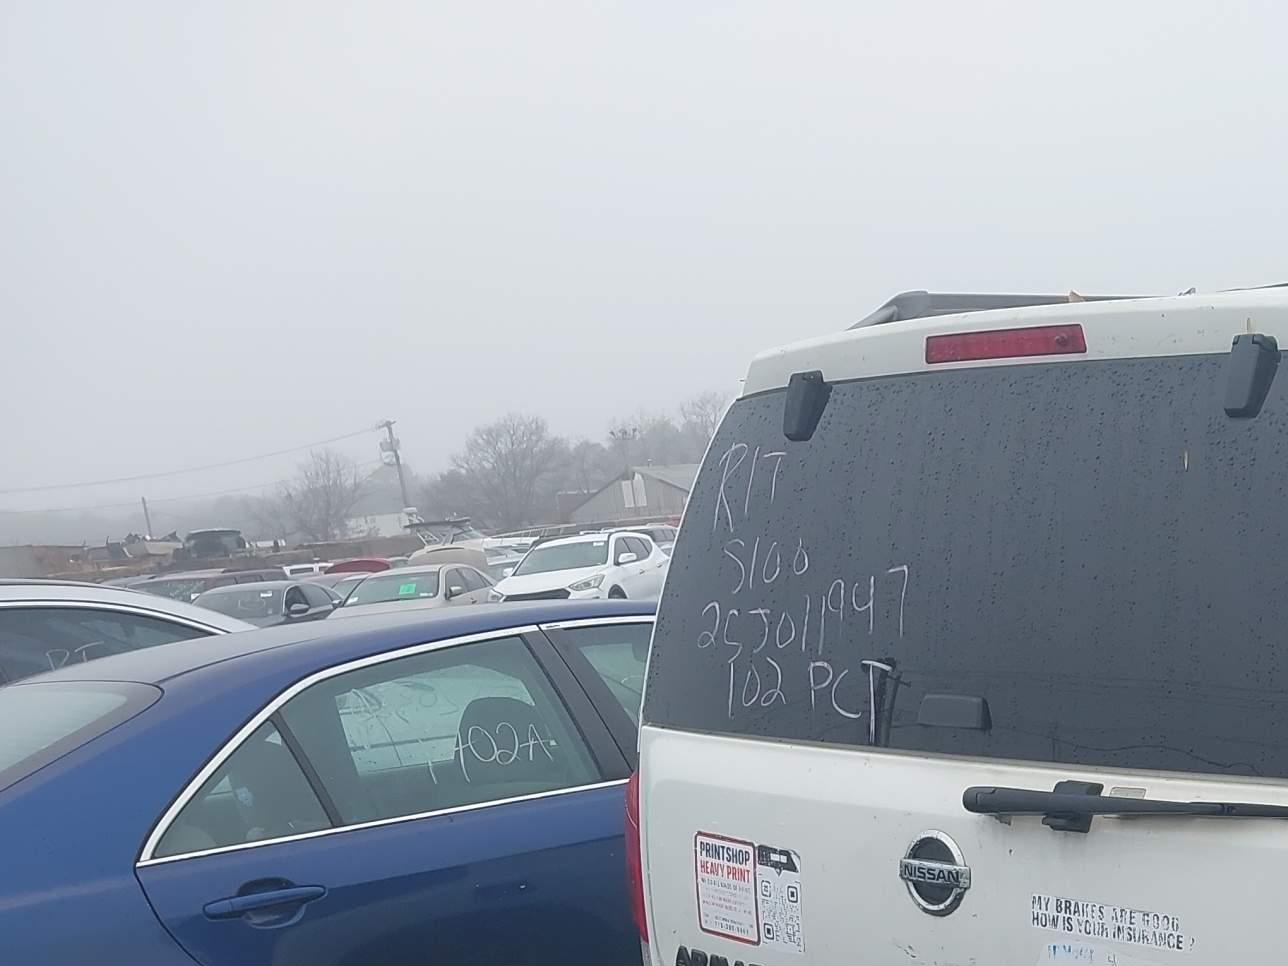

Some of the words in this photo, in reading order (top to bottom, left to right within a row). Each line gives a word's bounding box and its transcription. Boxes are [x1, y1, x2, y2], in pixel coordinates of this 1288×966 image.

[728, 657, 787, 720] 102
[700, 840, 750, 866] PRINTSHOP
[700, 860, 725, 878] HEAVY
[727, 865, 751, 883] PRINT
[903, 864, 961, 884] NISSAN
[1032, 896, 1050, 911] MY
[1055, 899, 1105, 921] BRAKES
[1111, 908, 1137, 926] ARE
[1032, 911, 1059, 929] HOW
[1063, 916, 1074, 932] IS
[1077, 918, 1109, 939] YOUR
[1112, 925, 1184, 950] INSURANCE
